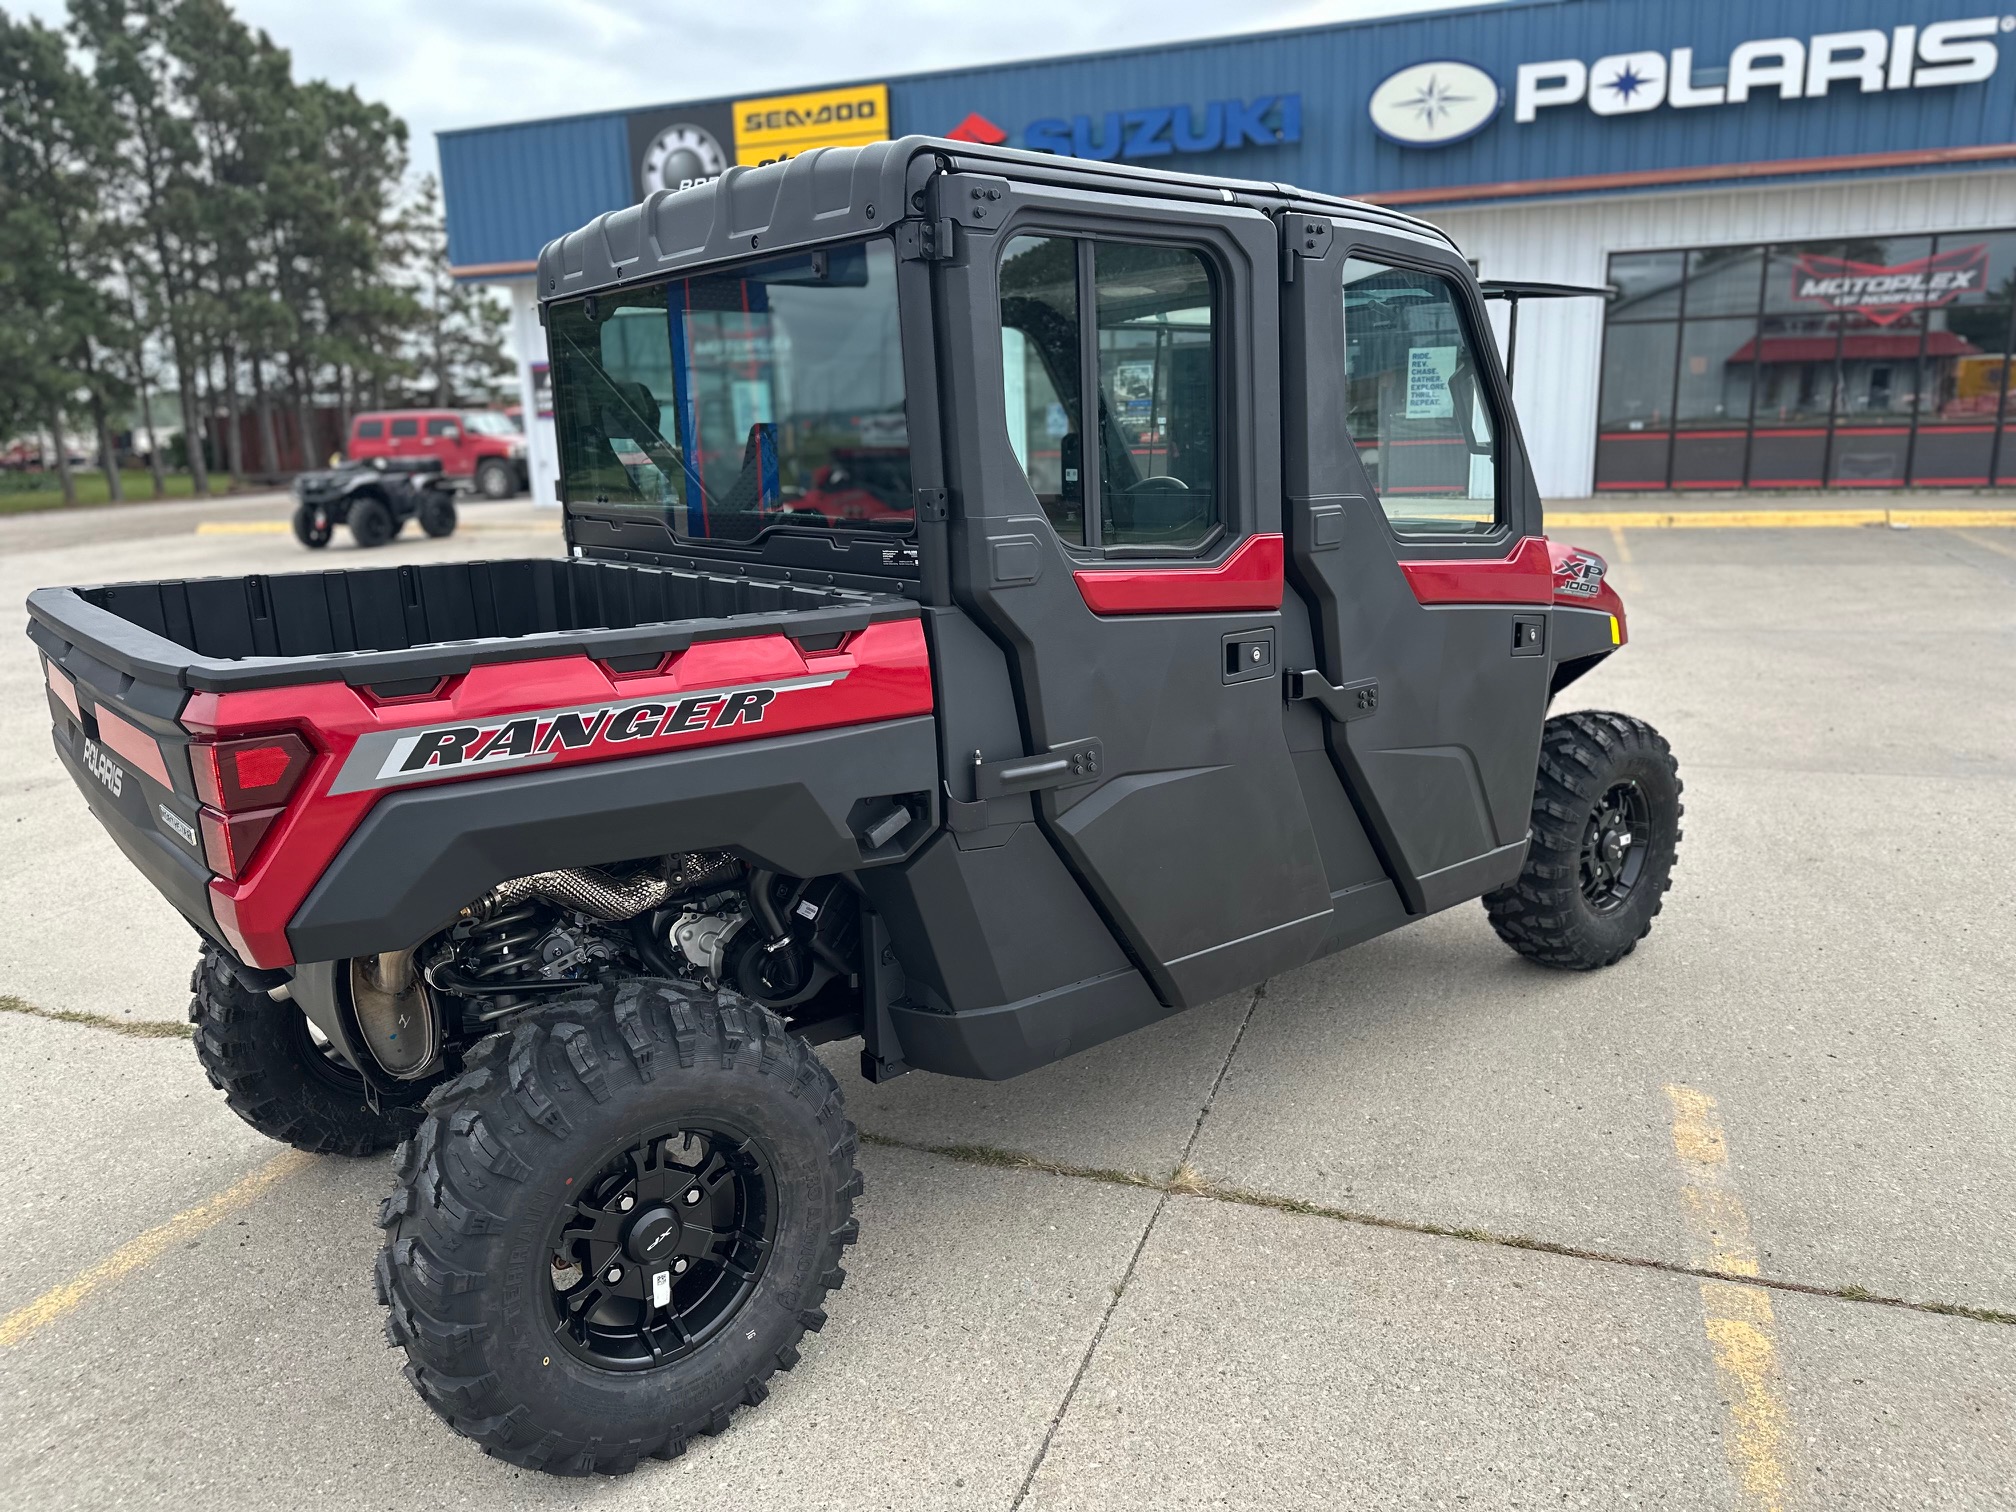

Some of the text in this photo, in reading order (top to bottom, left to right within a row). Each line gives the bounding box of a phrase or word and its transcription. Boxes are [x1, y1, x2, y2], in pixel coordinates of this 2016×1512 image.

[1515, 16, 1999, 123] POLARIS
[1024, 93, 1302, 161] SUZUKI
[1801, 269, 1977, 297] MOTOPLEX
[1412, 352, 1432, 360] RIDE.
[1410, 383, 1448, 391] EXPLORE.
[1555, 558, 1604, 580] XP
[1563, 580, 1600, 595] 1000
[398, 687, 776, 773] RANGER
[82, 736, 124, 798] POLARIS
